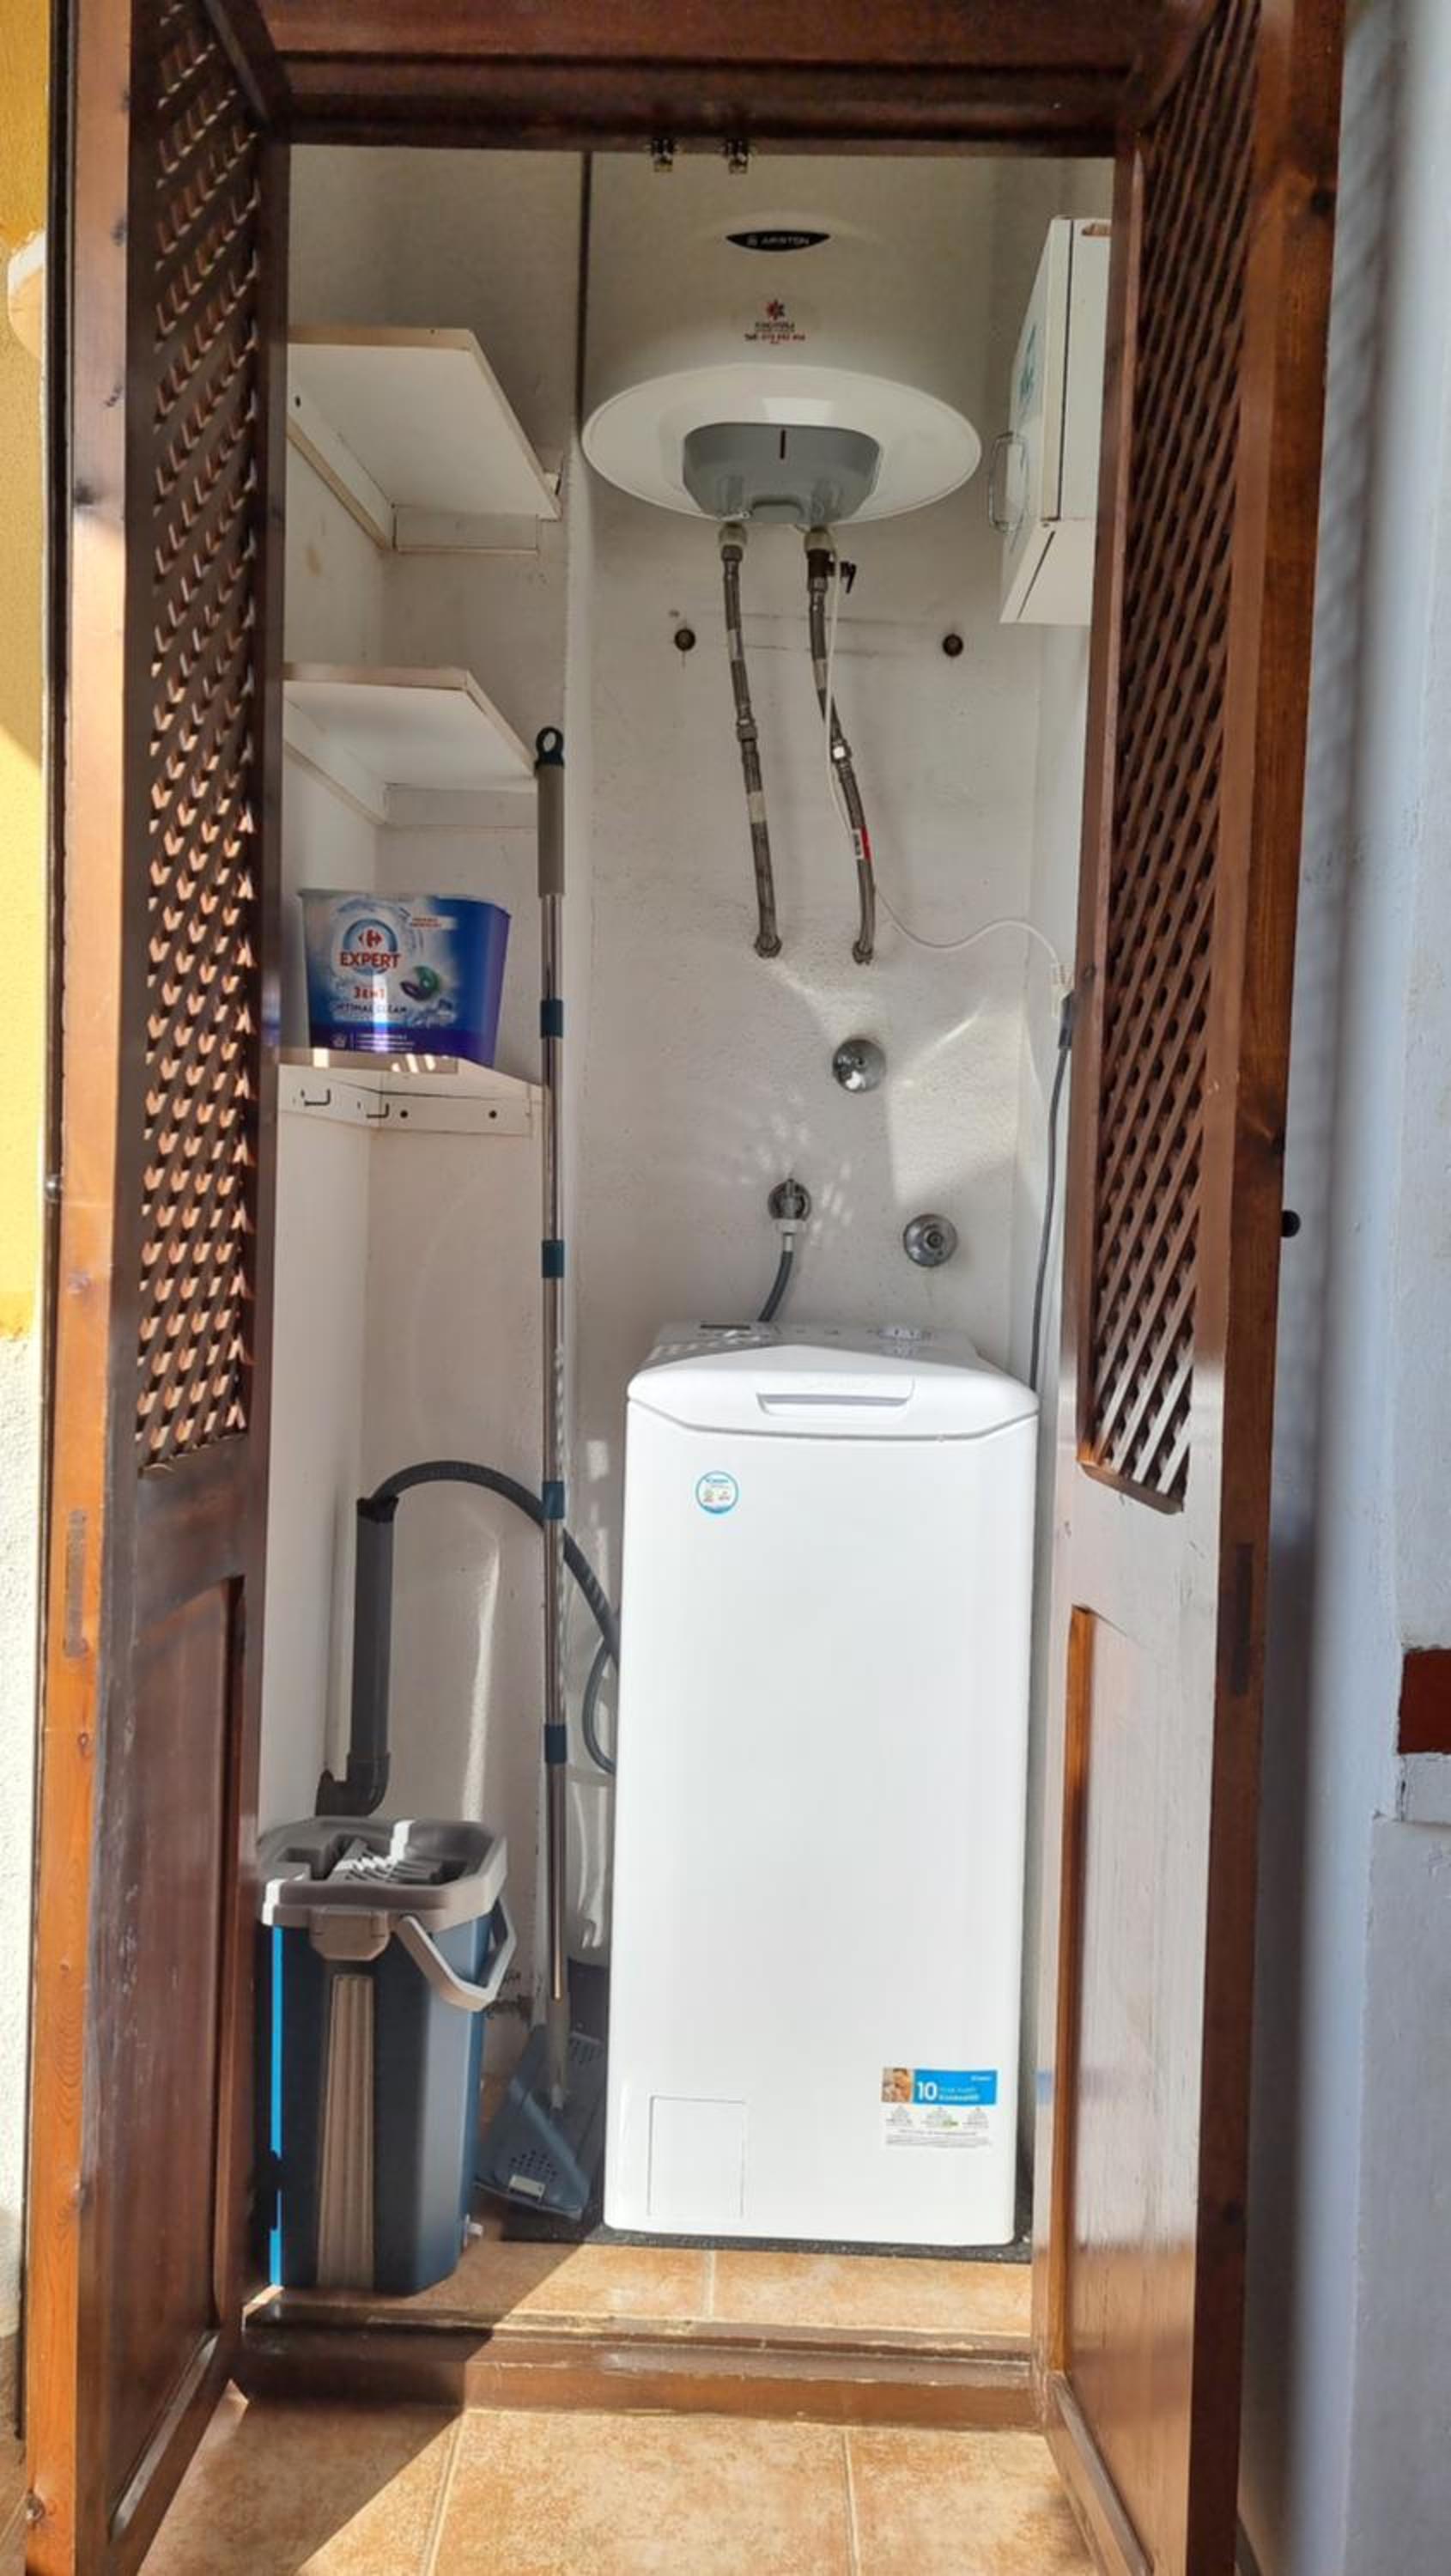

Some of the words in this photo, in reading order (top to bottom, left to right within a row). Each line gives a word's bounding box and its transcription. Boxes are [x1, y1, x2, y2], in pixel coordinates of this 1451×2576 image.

[761, 236, 810, 245] ARISTON
[340, 952, 401, 969] EXPERT
[917, 2081, 938, 2100] 10
